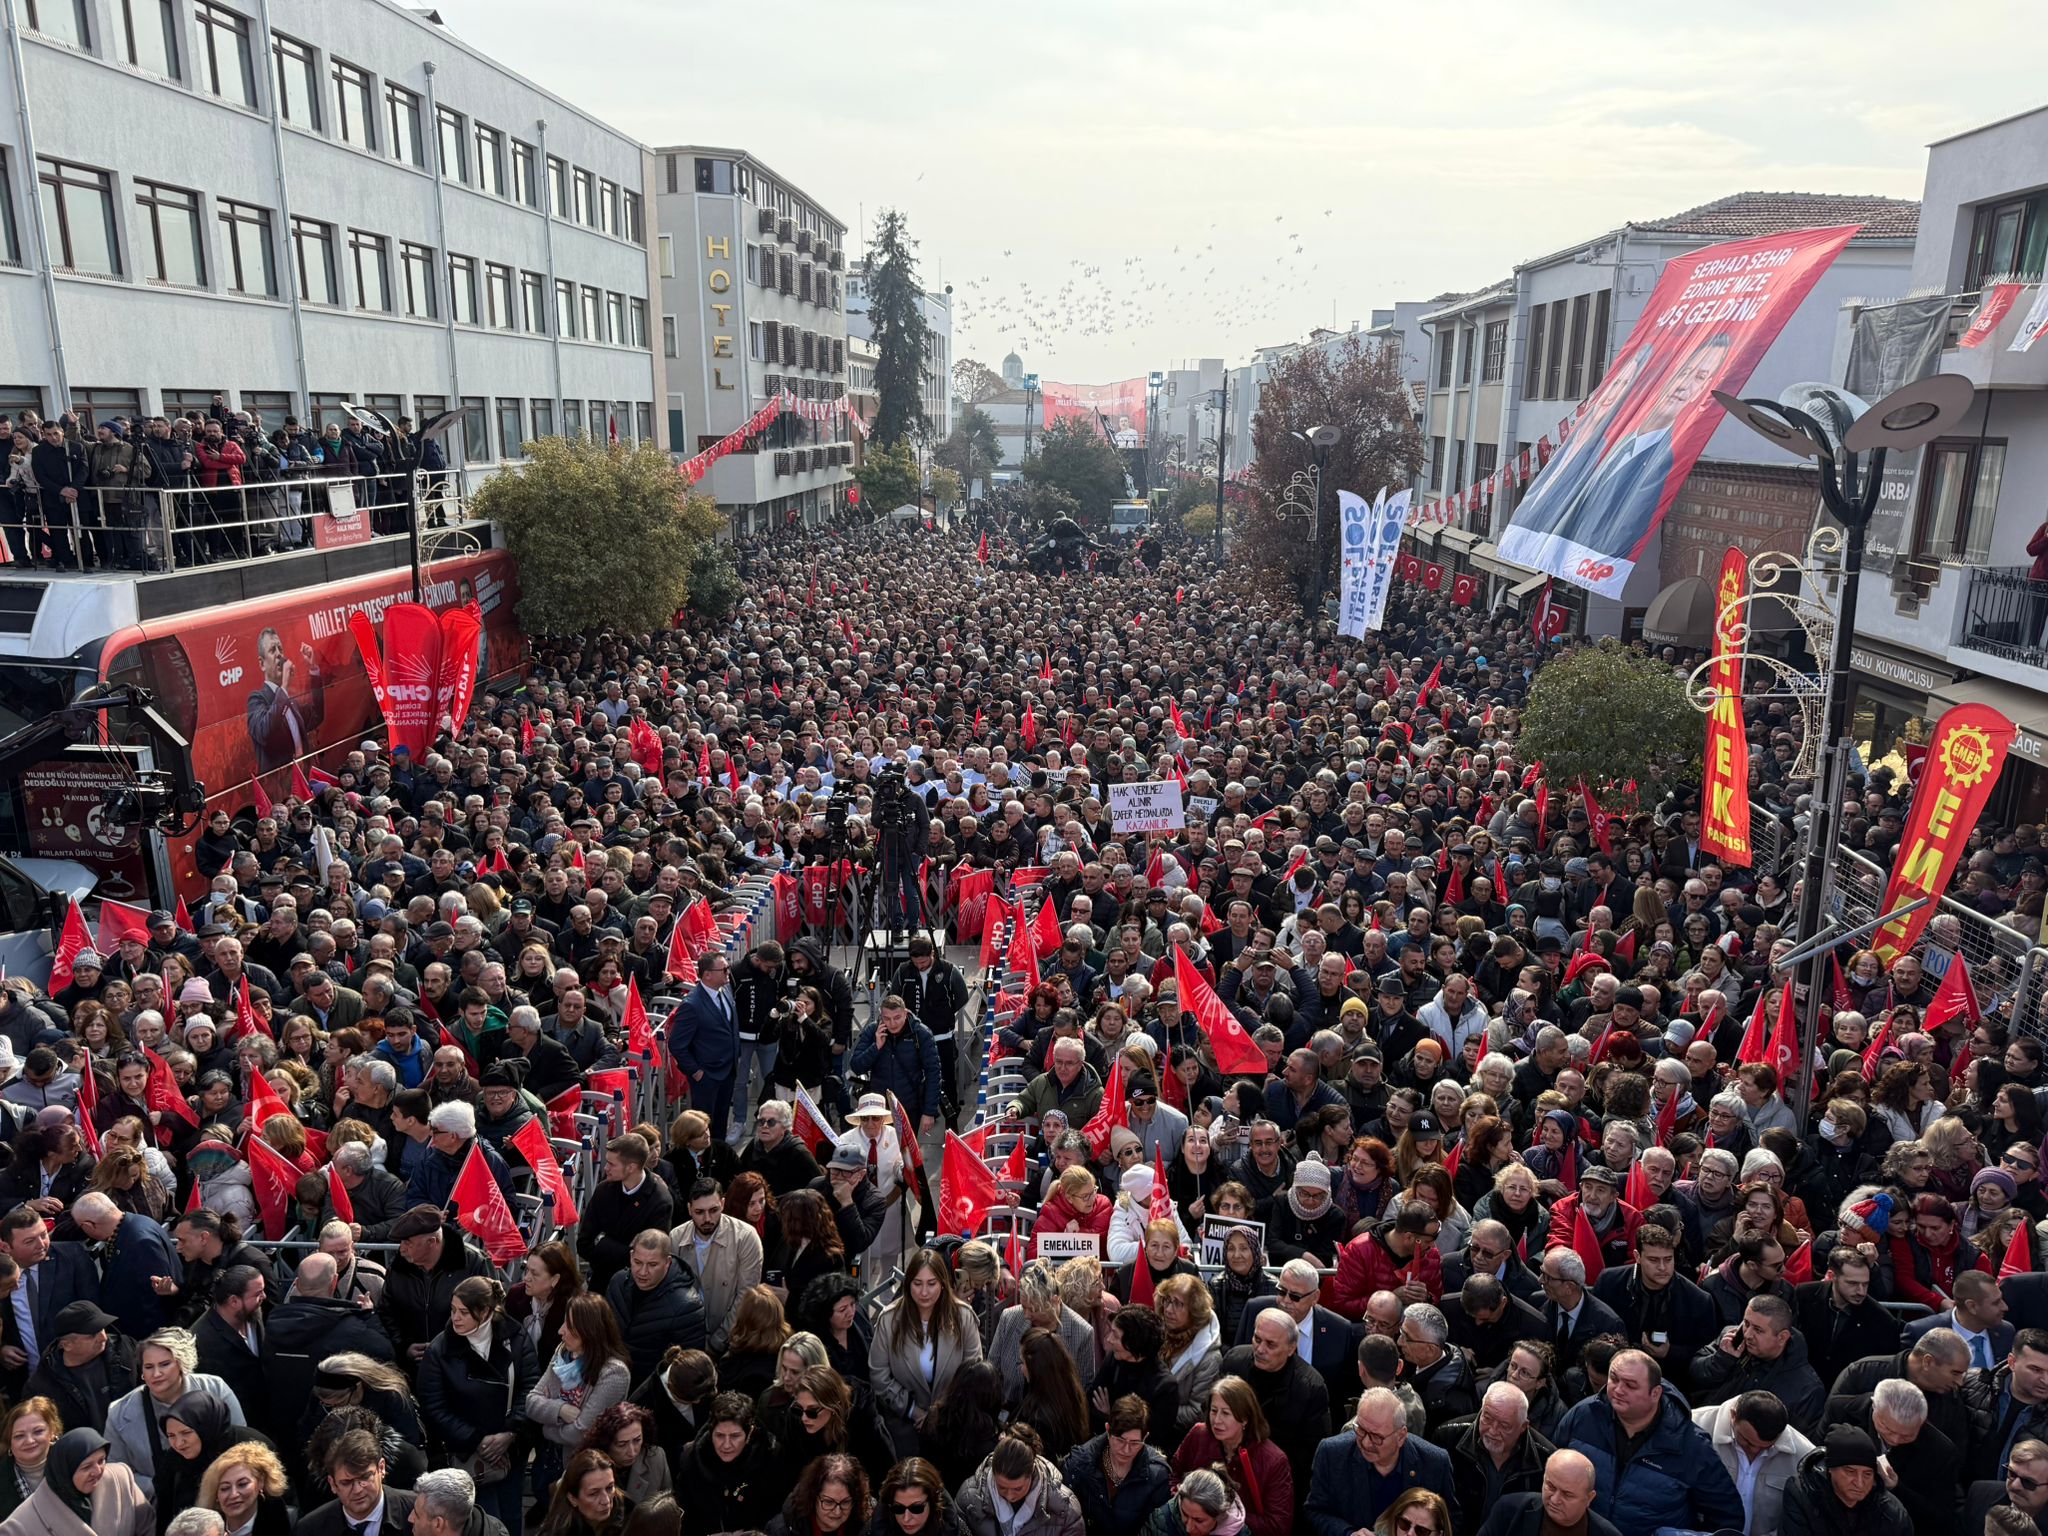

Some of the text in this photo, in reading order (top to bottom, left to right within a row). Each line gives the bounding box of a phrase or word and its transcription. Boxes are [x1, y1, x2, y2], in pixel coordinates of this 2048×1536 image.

[1690, 247, 1798, 281] SERHAD ŞEHRİ
[1680, 271, 1773, 301] EDİRNE'MİZE
[706, 235, 735, 391] HOTEL
[2025, 322, 2043, 335] CH
[1880, 481, 1910, 501] URBA
[1377, 503, 1404, 561] SOL
[1576, 558, 1615, 582] CHP
[308, 605, 347, 640] MİLLET
[1650, 631, 1679, 643] BAHARAT
[219, 666, 243, 687] CHP
[1876, 658, 1934, 689] KUYUMCUSU
[1713, 632, 1737, 828] EMEK
[1952, 742, 1982, 766] EMEP
[24, 779, 66, 787] DEDEOĞLU
[26, 771, 45, 779] YILIN
[57, 771, 80, 779] BÜYÜK
[1046, 771, 1065, 779] EKLİYİ
[90, 794, 101, 802] ÜR
[1112, 786, 1129, 798] HAK
[1127, 797, 1152, 808] ALINIR
[1113, 809, 1133, 820] ZAFER
[1126, 819, 1169, 832] KAZANILIR
[1707, 826, 1747, 853] PARTİSİ
[39, 849, 74, 857] PIRLANTA
[812, 883, 823, 909] CHP
[990, 921, 1004, 951] CHP
[1208, 1223, 1233, 1239] AHIM
[1043, 1237, 1093, 1251] EMEKLİLER
[1205, 1245, 1224, 1266] VA
